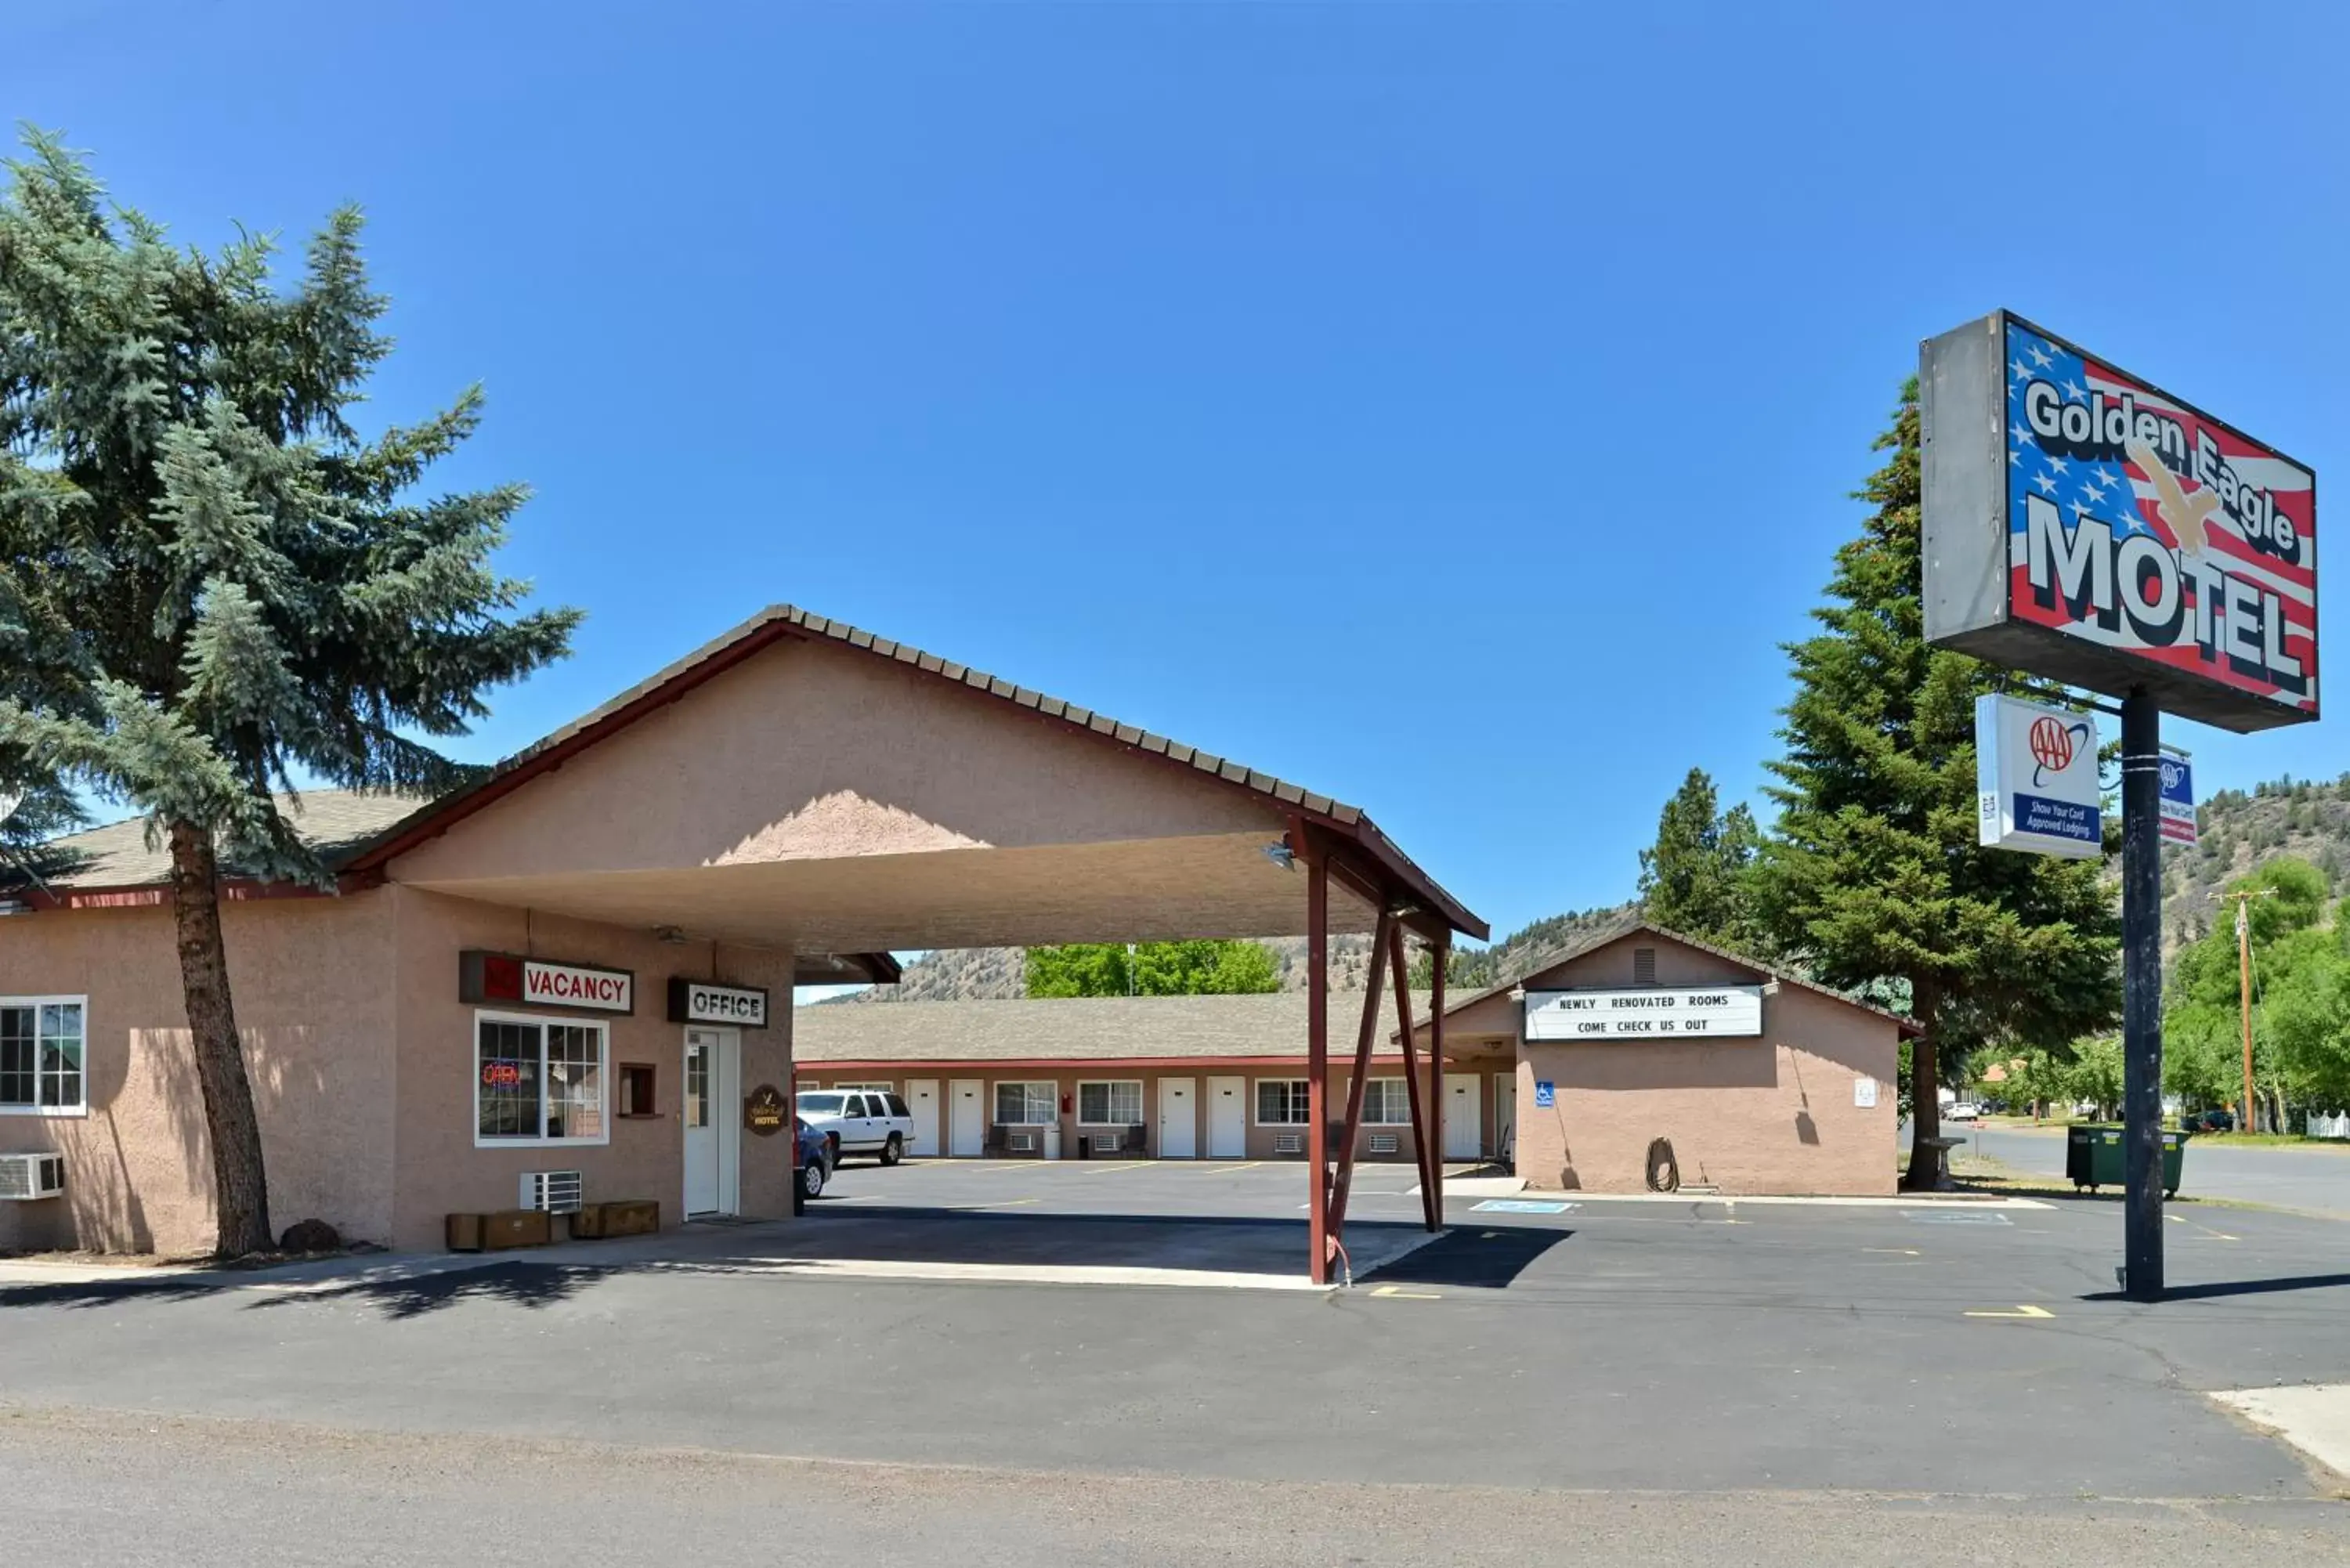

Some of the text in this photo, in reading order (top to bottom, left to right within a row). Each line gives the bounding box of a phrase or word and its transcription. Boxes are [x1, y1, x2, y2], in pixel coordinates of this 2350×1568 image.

[2025, 379, 2296, 551] Golden Eagle
[2026, 492, 2303, 680] MOTEL
[2032, 718, 2071, 769] AAA
[2030, 800, 2084, 821] Show Your Card
[2026, 815, 2090, 839] Approved Lodging
[527, 969, 625, 1003] VACANCY
[693, 991, 760, 1017] OFFICE
[1560, 995, 1729, 1010] NEWLY RENOVATED ROOMS
[1578, 1020, 1708, 1033] COME CHECK US OUT
[483, 1064, 519, 1085] OPEN
